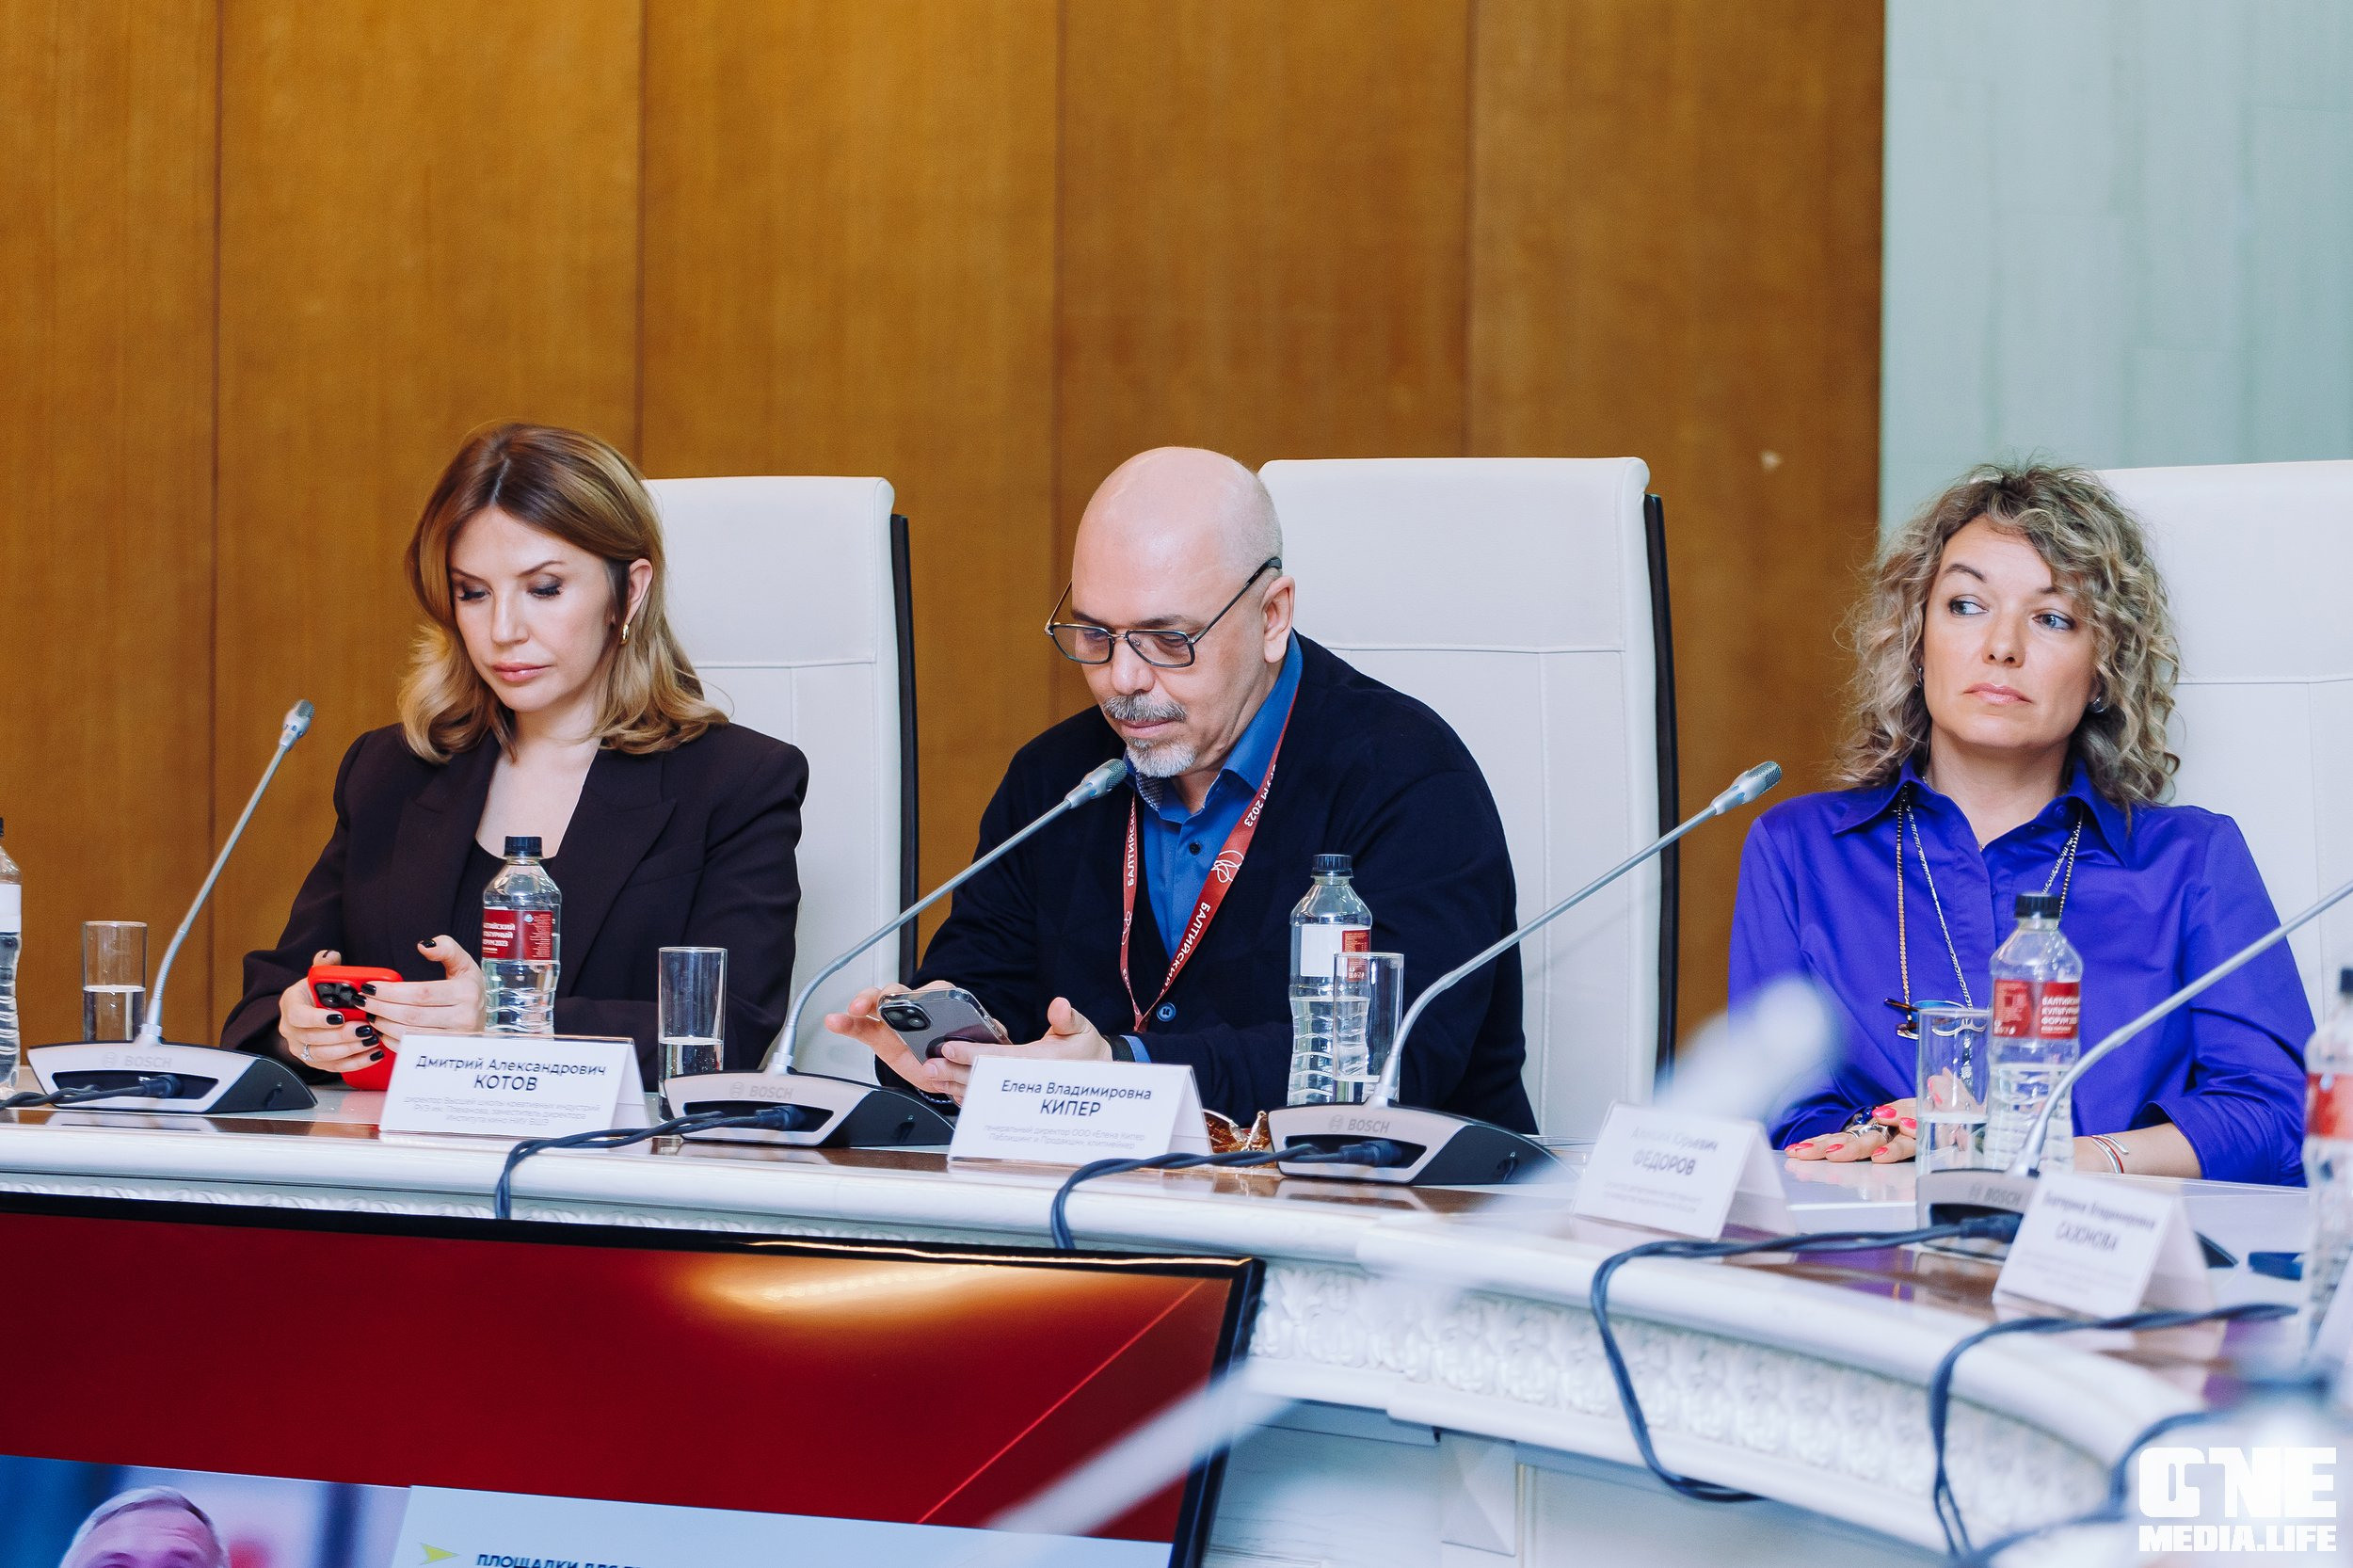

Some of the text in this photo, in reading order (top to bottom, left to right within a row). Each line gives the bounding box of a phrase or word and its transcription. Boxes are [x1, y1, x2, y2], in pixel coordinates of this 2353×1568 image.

[1244, 800, 1263, 826] 2023
[124, 1055, 172, 1068] BOSCH
[415, 1055, 606, 1077] Дмитрий Александрович
[473, 1075, 537, 1092] КОТОВ
[749, 1085, 794, 1099] BOSCH
[1001, 1080, 1152, 1100] Елена Владимировна
[1039, 1098, 1101, 1117] КИПЕР
[1348, 1118, 1390, 1134] BOSCH
[1631, 1149, 1697, 1176] ФЕДОРОВ
[1984, 1188, 2024, 1205] BOSCH
